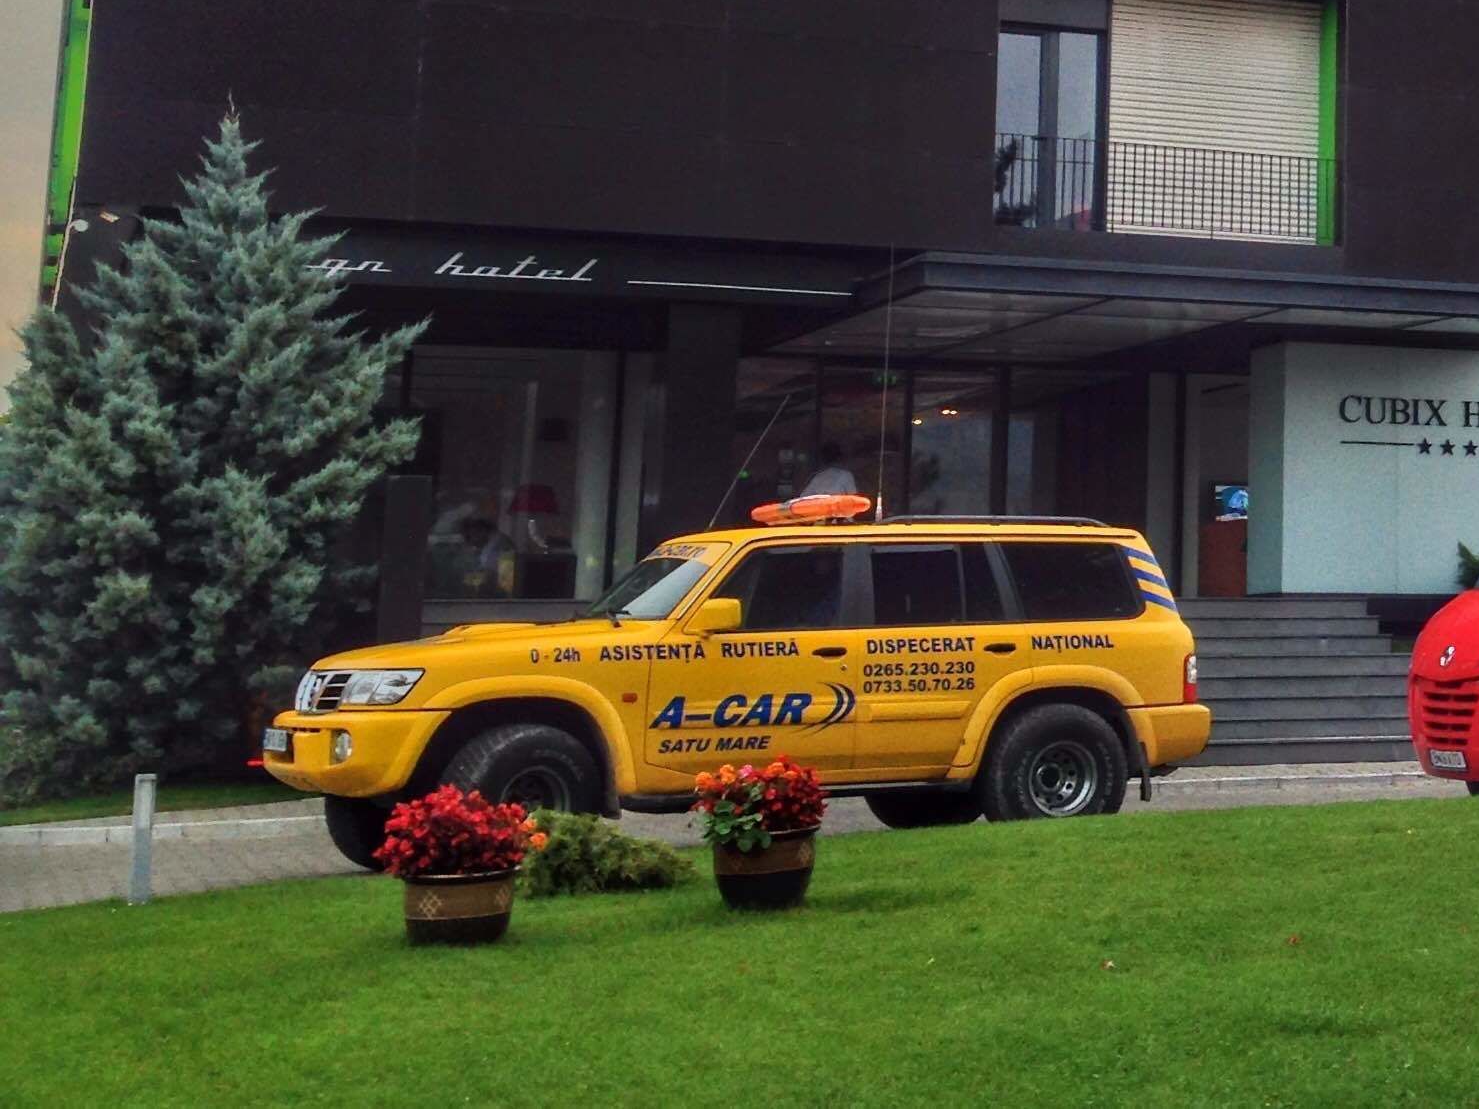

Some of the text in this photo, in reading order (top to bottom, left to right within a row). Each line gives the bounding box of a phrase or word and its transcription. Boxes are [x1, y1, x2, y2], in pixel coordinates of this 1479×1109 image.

[434, 251, 599, 281] hotel
[1339, 395, 1448, 427] CUBIX
[554, 647, 581, 663] 24h
[866, 636, 975, 654] DISPECERAT
[863, 661, 975, 677] 0265.230.230
[863, 677, 975, 694] 0733.50.70.26
[658, 735, 771, 754] SATU MARE
